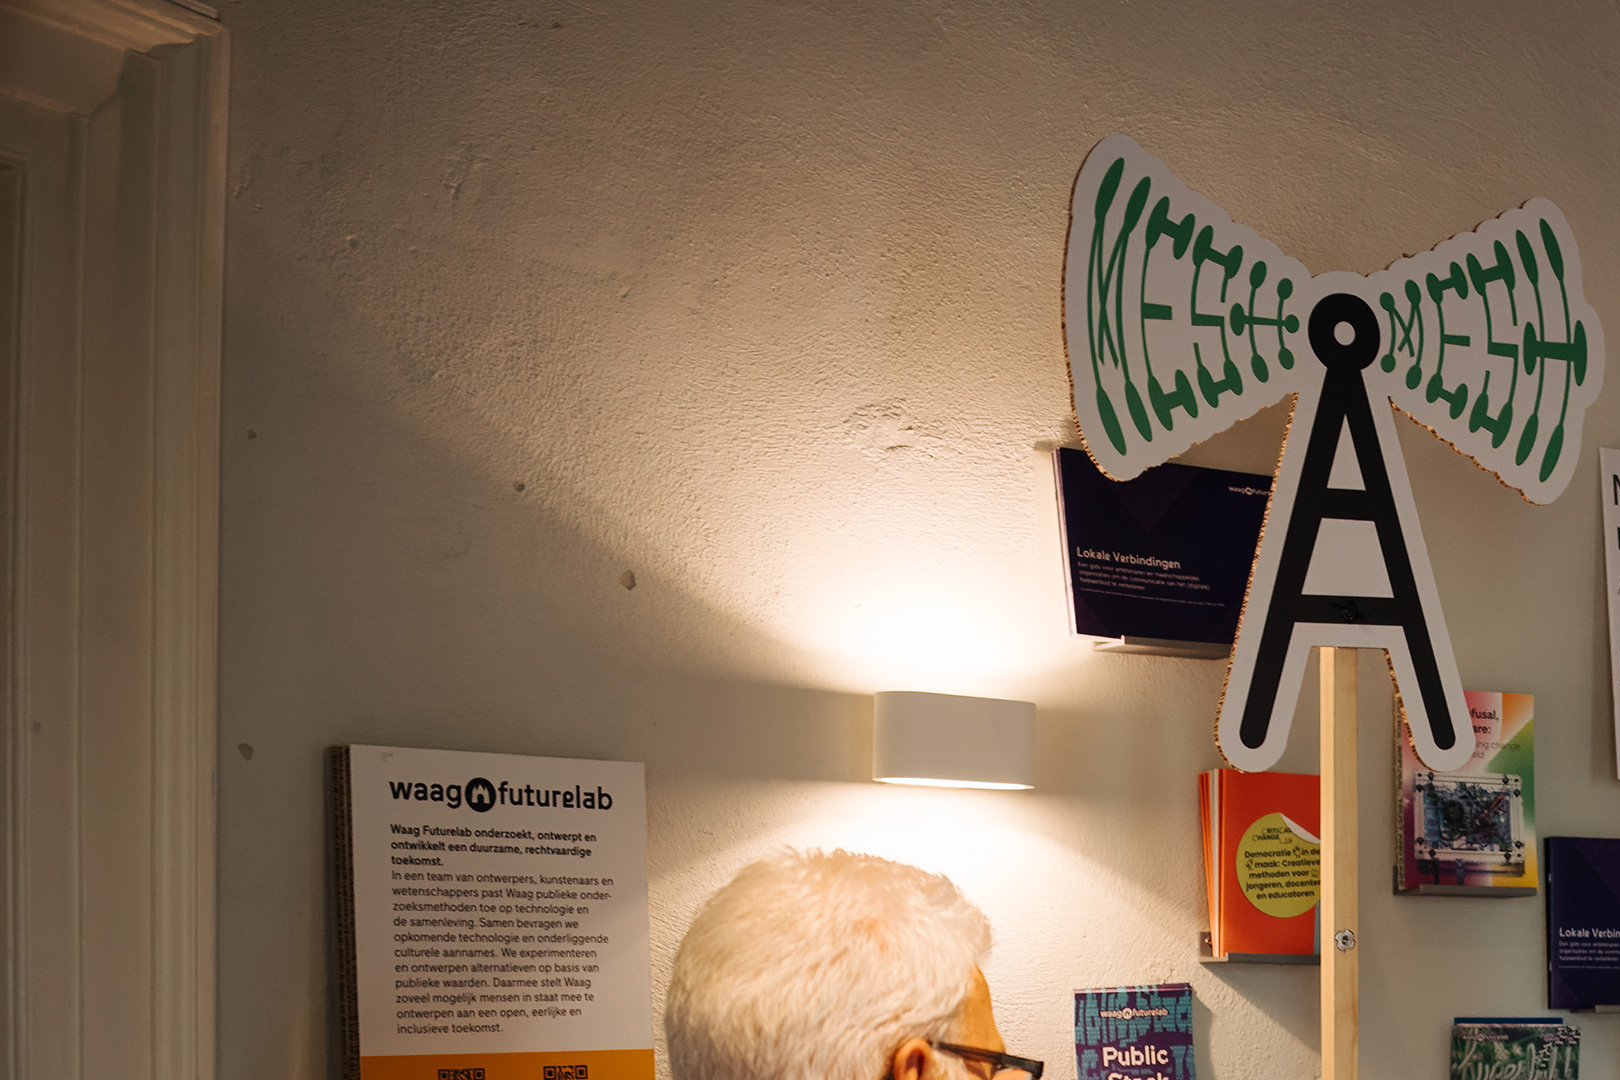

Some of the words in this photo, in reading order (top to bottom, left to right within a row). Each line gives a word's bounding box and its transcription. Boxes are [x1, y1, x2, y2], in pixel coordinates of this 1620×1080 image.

[1087, 156, 1299, 456] MESH
[1379, 218, 1588, 483] MESH
[1076, 546, 1111, 562] Lokale
[1112, 551, 1181, 571] Verbindingen
[388, 780, 462, 809] waag
[498, 781, 614, 811] futurelab
[390, 823, 420, 837] Waag
[423, 825, 472, 837] Futurelab
[474, 828, 535, 840] onderzoekt,
[537, 832, 583, 843] ontwerpt
[584, 834, 597, 842] en
[391, 840, 446, 851] ontwikkelt
[448, 843, 467, 851] een
[469, 842, 523, 855] duurzame,
[525, 845, 592, 858] rechtvaardige
[1245, 848, 1291, 858] Democratie
[391, 855, 444, 866] toekomst.
[1255, 861, 1280, 869] maak:
[392, 870, 402, 880] In
[404, 872, 424, 881] een
[427, 872, 453, 881] team
[455, 874, 474, 882] van
[476, 874, 537, 885] ontwerpers,
[539, 875, 599, 886] kunstenaars
[601, 878, 614, 886] en
[1249, 871, 1290, 879] methoden
[1246, 882, 1283, 892] jongeren,
[392, 887, 479, 898] wetenschappers
[481, 889, 503, 899] past
[505, 888, 534, 901] Waag
[536, 889, 578, 900] publieke
[580, 891, 612, 900] onder-
[1268, 891, 1315, 899] educatoren
[392, 901, 477, 912] zoeksmethoden
[479, 903, 497, 913] toe
[499, 905, 513, 915] op
[515, 903, 574, 916] technologie
[576, 906, 589, 914] en
[393, 916, 408, 927] de
[410, 917, 477, 929] samenleving.
[479, 917, 514, 928] Samen
[516, 918, 562, 930] bevragen
[393, 932, 456, 944] opkomende
[458, 933, 520, 945] technologie
[522, 934, 535, 943] en
[537, 933, 610, 946] onderliggende
[1559, 927, 1590, 938] Lokale
[394, 947, 440, 957] culturele
[442, 949, 499, 957] aannames.
[501, 947, 517, 958] We
[519, 948, 597, 959] experimenteren
[395, 964, 409, 973] en
[411, 963, 468, 975] ontwerpen
[471, 963, 536, 973] alternatieven
[538, 964, 552, 974] op
[554, 963, 580, 973] basis
[582, 964, 600, 973] van
[395, 978, 440, 990] publieke
[443, 977, 491, 988] waarden.
[493, 977, 538, 988] Daarmee
[540, 978, 562, 988] stelt
[564, 978, 592, 989] Waag
[396, 993, 430, 1004] zoveel
[432, 992, 476, 1005] mogelijk
[480, 994, 519, 1002] mensen
[522, 992, 532, 1002] in
[534, 993, 558, 1002] staat
[561, 994, 582, 1002] mee
[584, 993, 594, 1002] te
[396, 1009, 455, 1020] ontwerpen
[457, 1009, 476, 1018] aan
[478, 1009, 497, 1018] een
[500, 1008, 529, 1019] open,
[531, 1006, 567, 1019] eerlijke
[569, 1008, 582, 1016] en
[1100, 1009, 1123, 1020] waag
[1132, 1007, 1169, 1017] futurelab
[397, 1023, 449, 1034] inclusieve
[451, 1023, 503, 1033] toekomst.
[1102, 1045, 1169, 1068] Public
